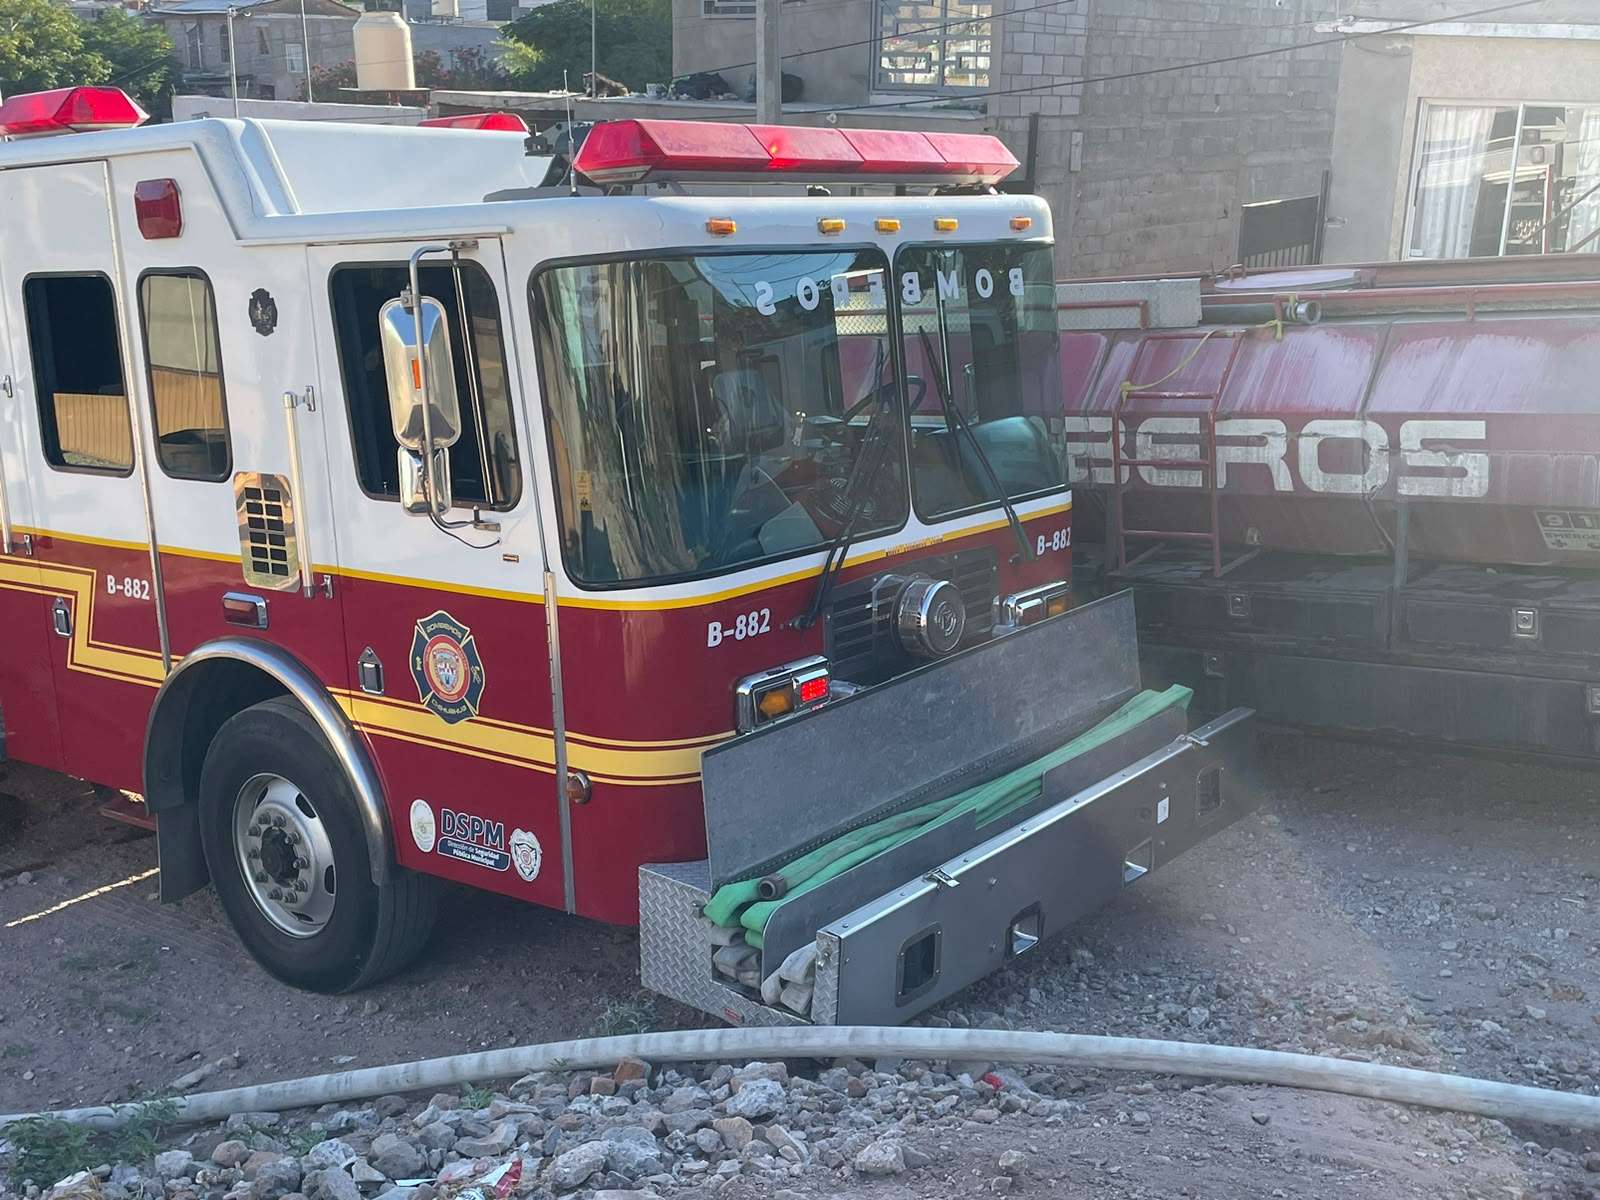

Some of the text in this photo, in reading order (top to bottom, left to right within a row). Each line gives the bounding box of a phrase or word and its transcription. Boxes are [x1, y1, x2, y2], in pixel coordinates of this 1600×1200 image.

[1036, 527, 1071, 556] B-882
[106, 574, 150, 601] B-882
[707, 608, 770, 648] B-882
[441, 808, 504, 850] DSPM
